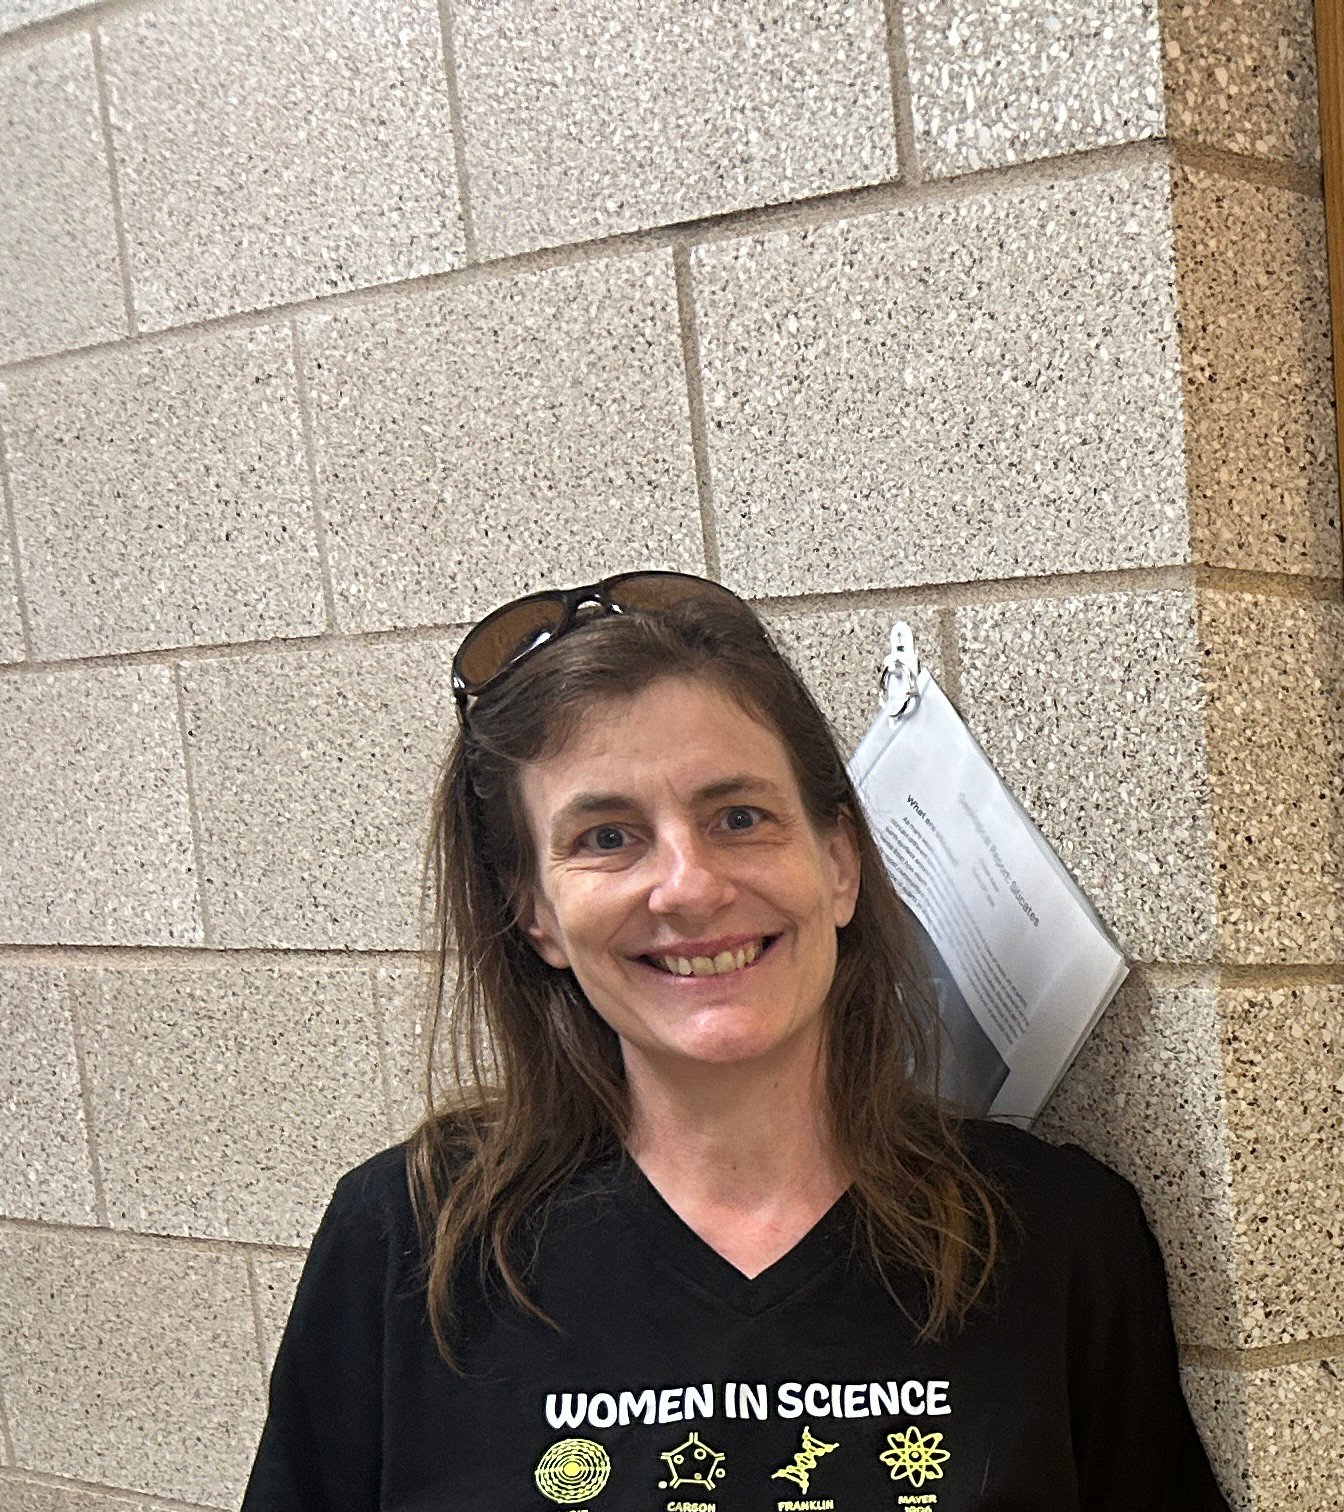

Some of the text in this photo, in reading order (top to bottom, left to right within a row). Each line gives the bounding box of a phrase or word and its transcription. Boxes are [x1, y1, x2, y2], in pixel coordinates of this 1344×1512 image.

[907, 794, 926, 819] What
[546, 1381, 951, 1429] WOMEN IN SCIENCE
[898, 1495, 937, 1504] MAYER
[667, 1502, 716, 1512] CARSON
[778, 1500, 834, 1511] FRANKLIN
